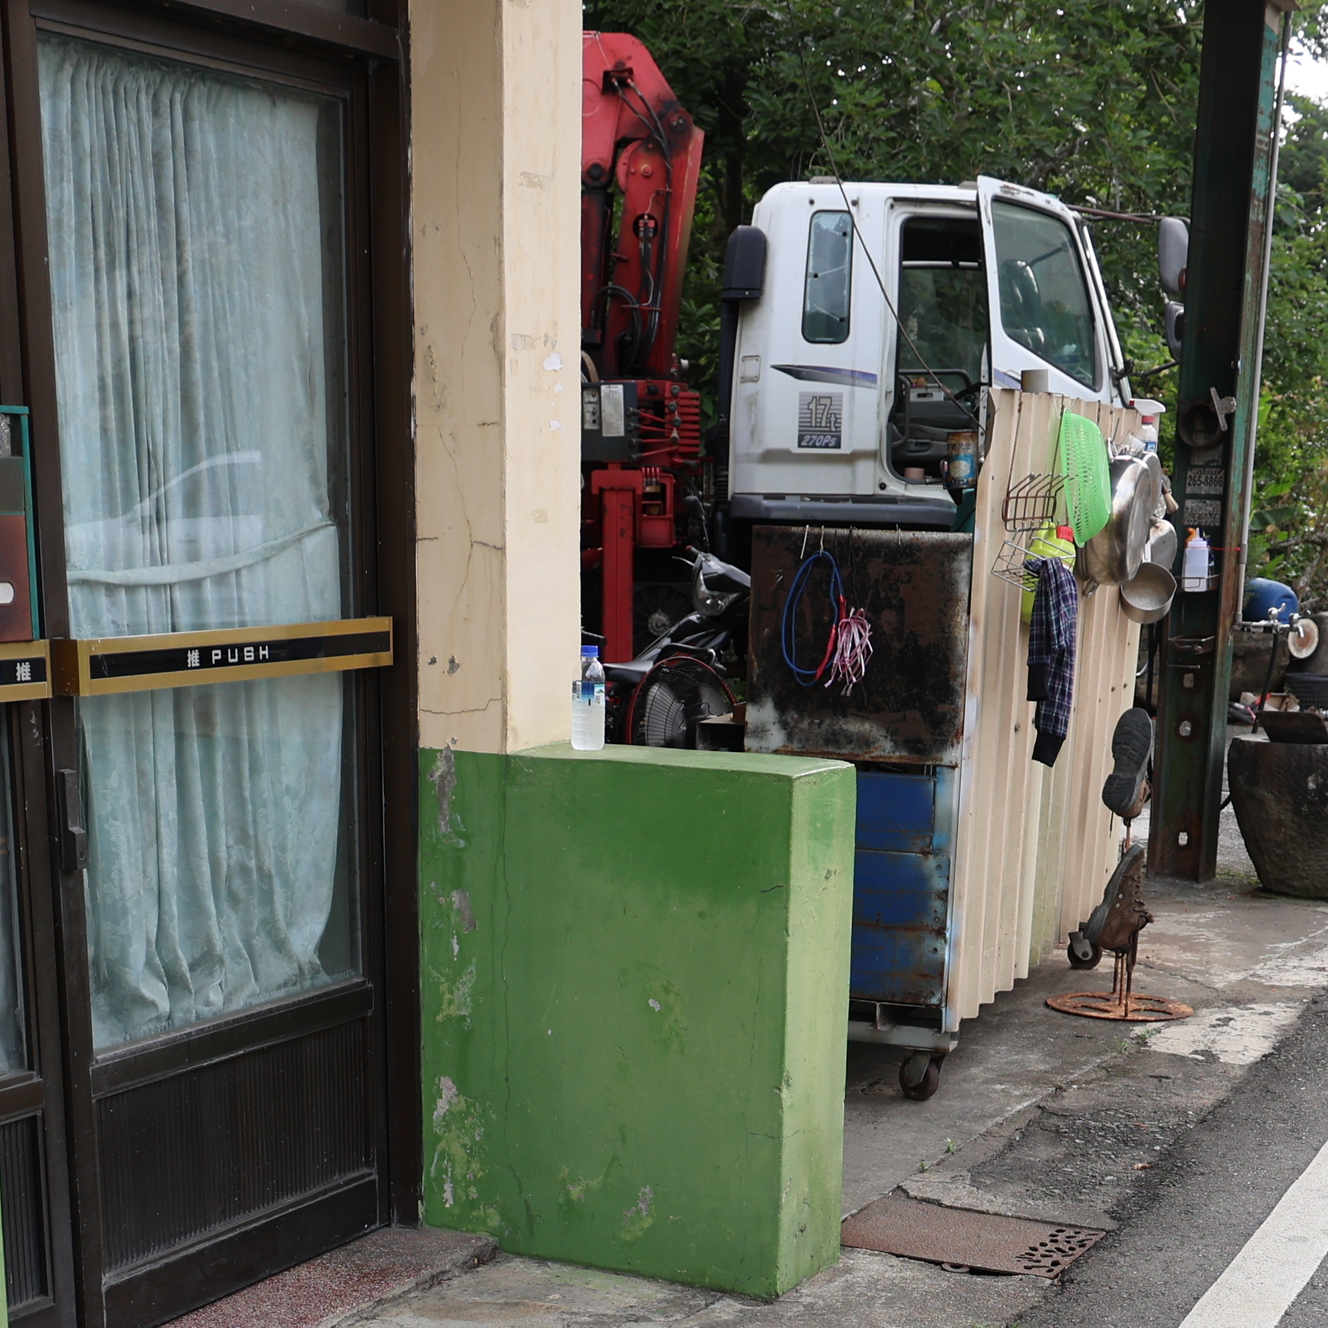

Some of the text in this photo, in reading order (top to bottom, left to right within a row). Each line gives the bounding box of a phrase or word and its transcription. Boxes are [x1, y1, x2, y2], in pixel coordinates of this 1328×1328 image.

[1187, 475, 1223, 487] 265-8866
[187, 645, 269, 668] 推 PUSH
[16, 661, 32, 682] 推
